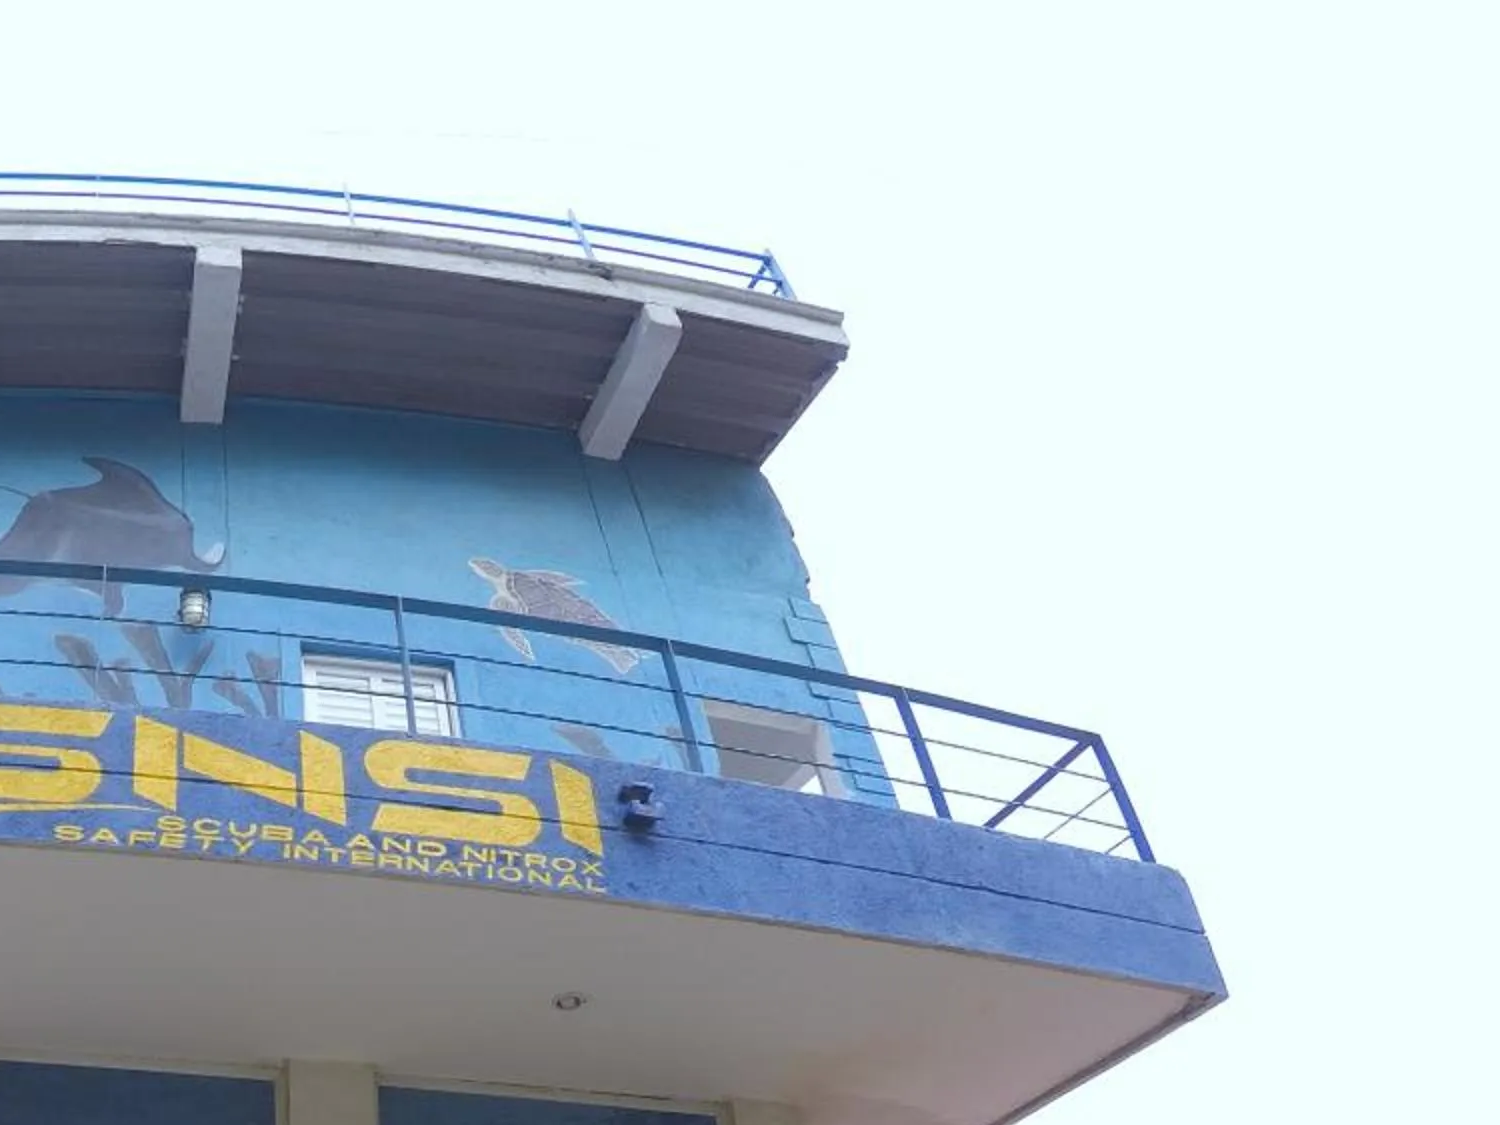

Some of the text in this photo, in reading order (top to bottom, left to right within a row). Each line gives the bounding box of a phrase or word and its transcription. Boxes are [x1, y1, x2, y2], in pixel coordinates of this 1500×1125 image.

[52, 823, 608, 894] SAFETY INTERNATIONAL
[155, 815, 605, 877] SCUBA AND NITROX
